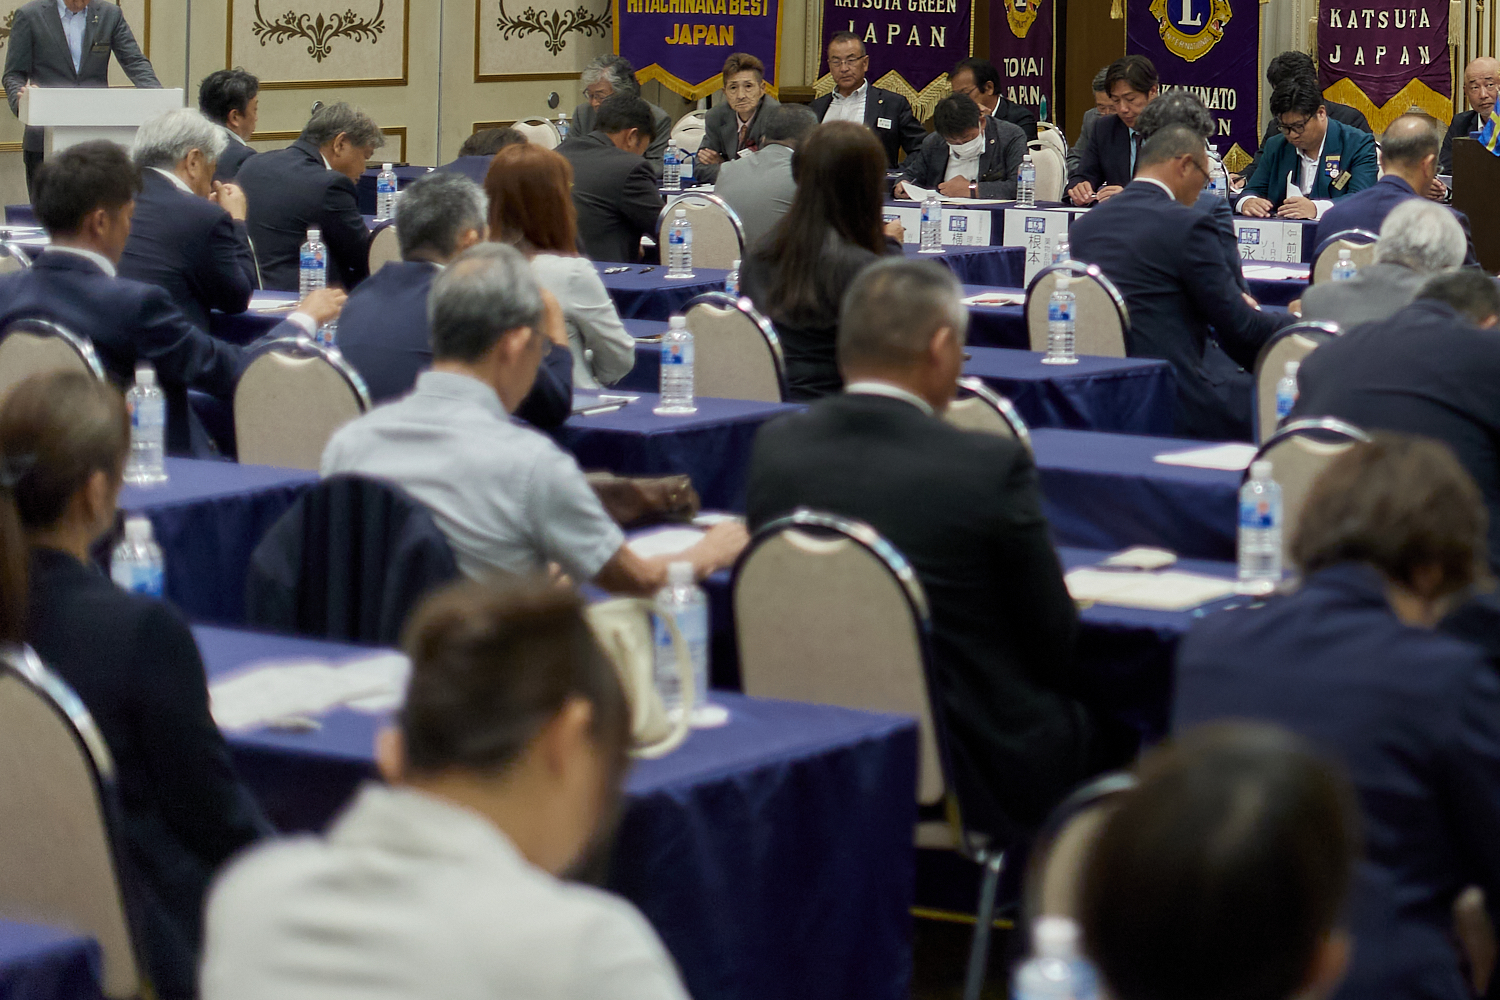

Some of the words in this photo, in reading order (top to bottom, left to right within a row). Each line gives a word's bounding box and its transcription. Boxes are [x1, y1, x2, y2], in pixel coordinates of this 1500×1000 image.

[1330, 7, 1431, 29] KATSUTA
[665, 23, 734, 46] JAPAN
[1329, 44, 1431, 65] JAPAN
[1003, 57, 1043, 78] TOKAI
[1007, 85, 1040, 106] APAN
[1028, 234, 1041, 265] 根本
